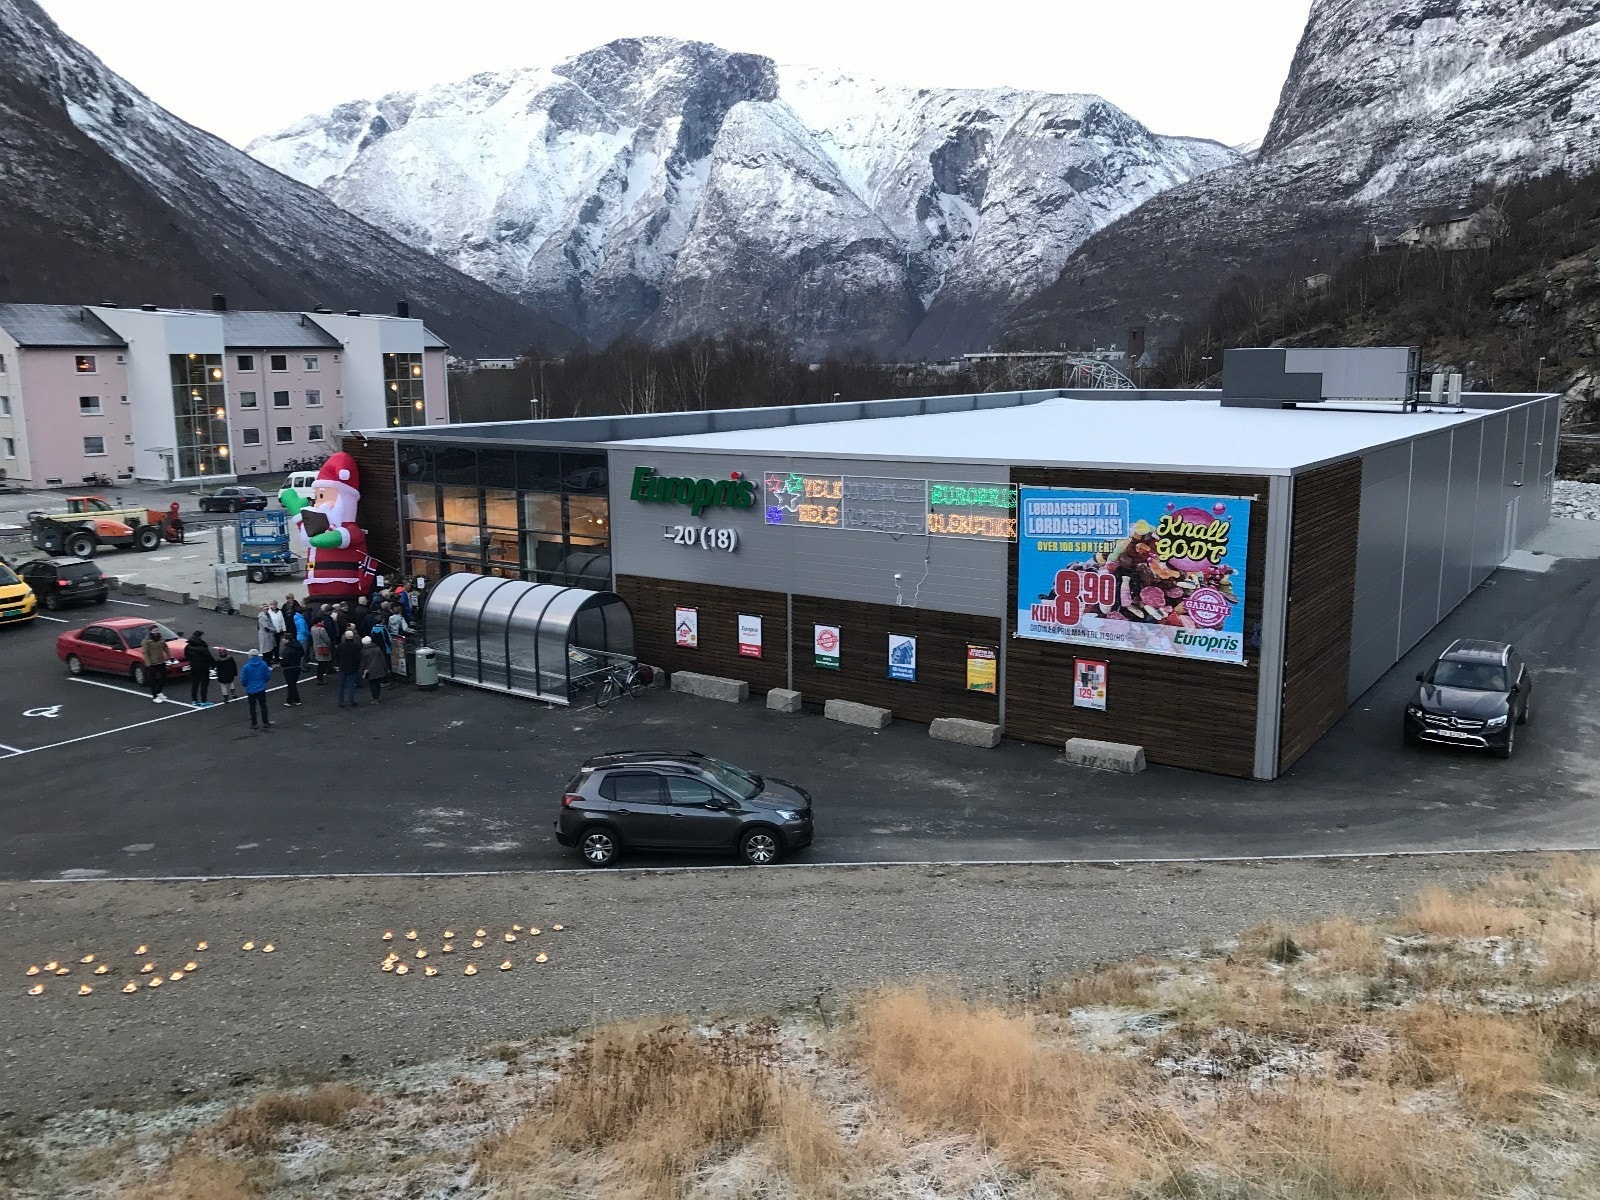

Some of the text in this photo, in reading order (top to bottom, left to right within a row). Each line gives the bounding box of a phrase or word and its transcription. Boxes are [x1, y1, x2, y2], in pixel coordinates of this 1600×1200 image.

[630, 465, 757, 517] Europris
[1028, 502, 1120, 516] LØRDAGSGODT TIL
[1029, 517, 1123, 535] LØRDAGSPRIS!
[1156, 515, 1230, 543] Knall
[701, 527, 737, 552] (18)
[1037, 541, 1058, 552] OVER
[1060, 541, 1074, 553] 100
[1155, 538, 1228, 564] GODT
[1031, 603, 1057, 623] KUN
[1185, 600, 1230, 615] GARANTI
[1173, 629, 1239, 652] Europris
